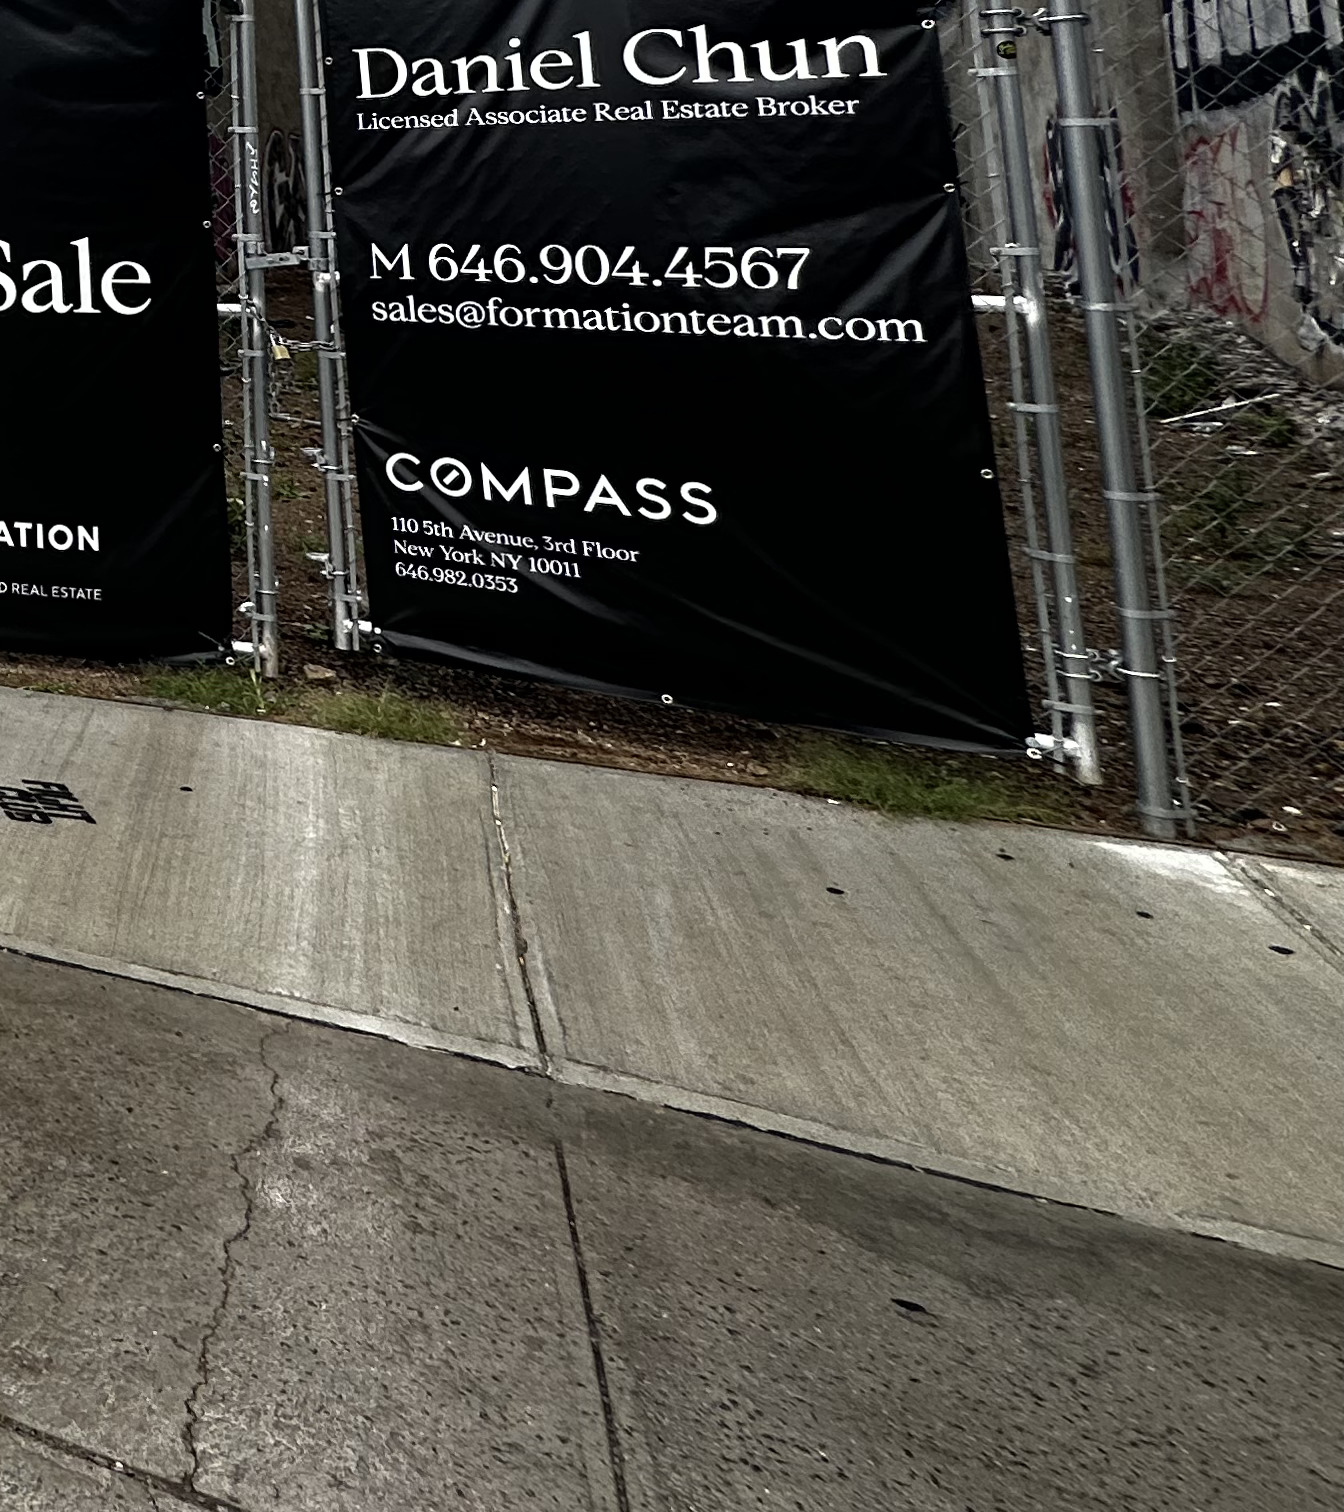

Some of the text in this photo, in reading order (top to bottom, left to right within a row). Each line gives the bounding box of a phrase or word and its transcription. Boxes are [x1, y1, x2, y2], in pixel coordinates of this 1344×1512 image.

[352, 23, 888, 100] Daniel Chun
[356, 94, 860, 131] Licensed Associate Real Estate Broker
[369, 242, 811, 290] M 646.904.4567
[371, 295, 928, 343] sales@formationteam.com
[385, 450, 720, 526] COMPASS
[390, 516, 640, 563] 110 5th Avenue, 3rd Floor
[394, 539, 582, 578] New York NY 10011
[11, 582, 48, 597] REAL
[51, 586, 102, 601] ESTATE
[395, 561, 519, 593] 646.982.0353
